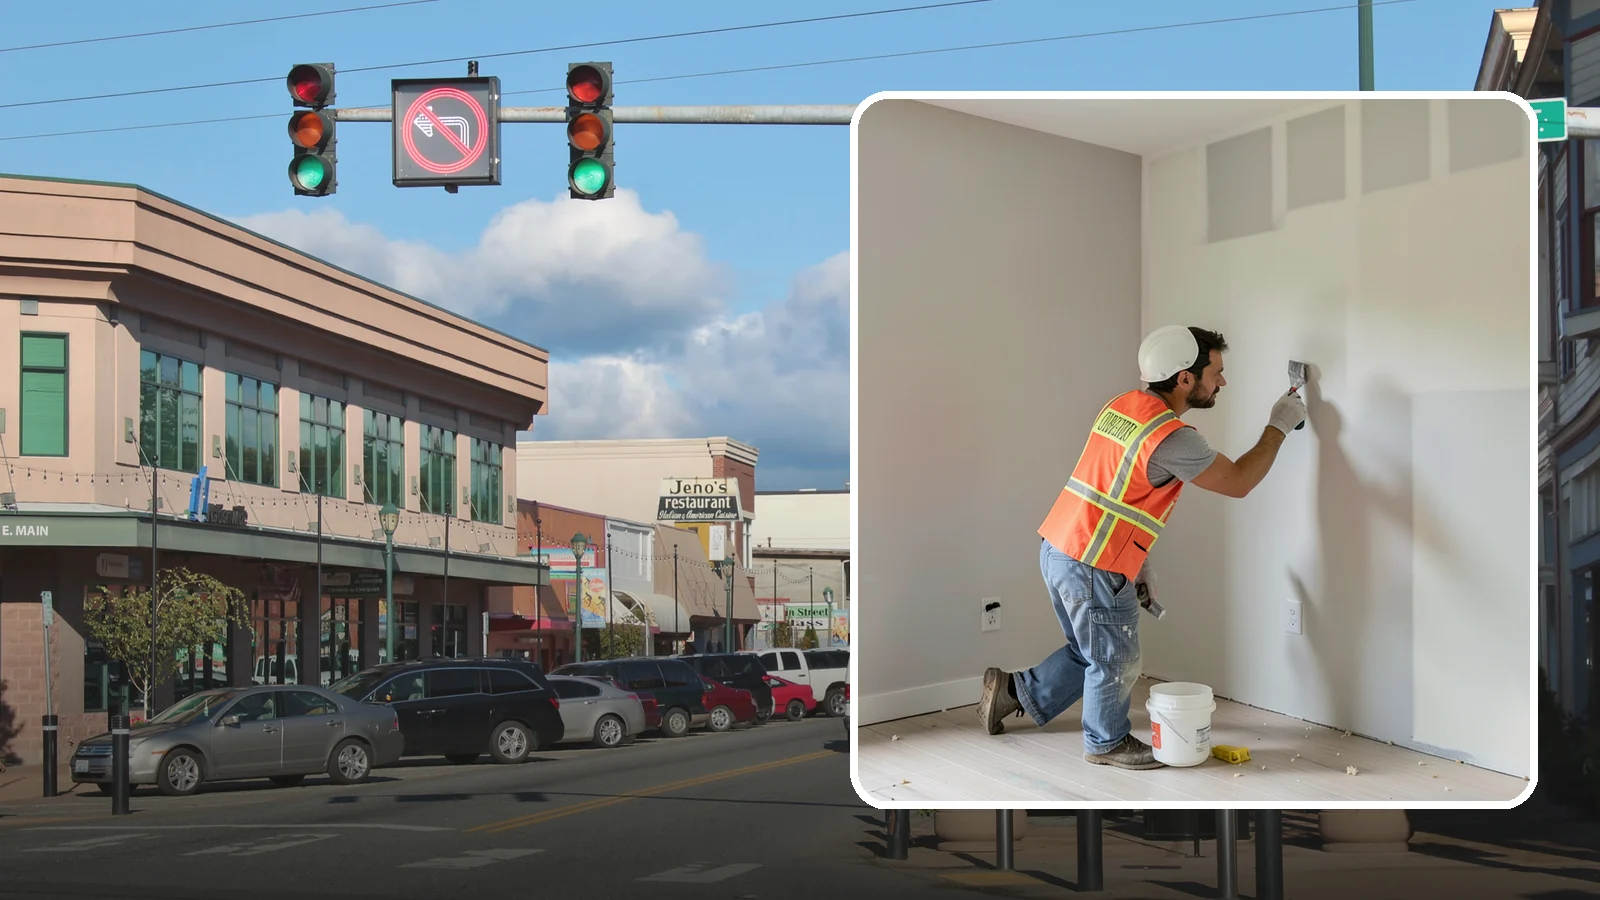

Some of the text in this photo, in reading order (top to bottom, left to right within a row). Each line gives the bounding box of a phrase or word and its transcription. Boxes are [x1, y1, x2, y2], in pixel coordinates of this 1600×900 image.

[669, 480, 728, 494] Jeno's
[665, 496, 731, 509] restaurant
[658, 510, 681, 519] Italian
[686, 510, 715, 519] American
[715, 510, 737, 519] Cuisine
[2, 525, 49, 536] E. MAIN
[797, 608, 828, 617] Street
[791, 619, 824, 627] lass
